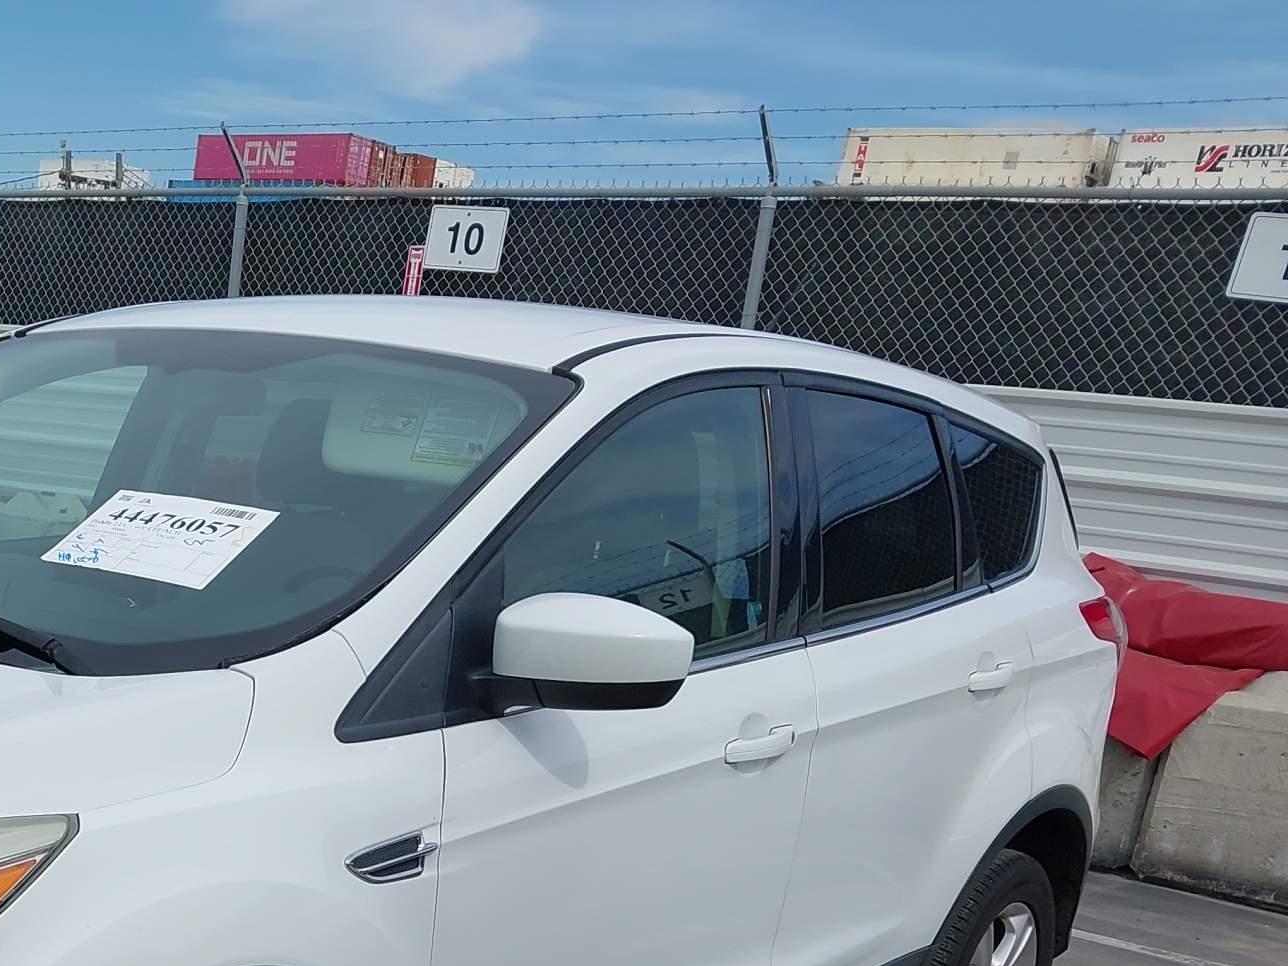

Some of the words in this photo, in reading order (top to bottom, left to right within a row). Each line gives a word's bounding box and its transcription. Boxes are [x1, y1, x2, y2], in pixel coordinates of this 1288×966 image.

[1130, 133, 1165, 143] seaco
[243, 141, 297, 166] ONE
[448, 221, 485, 256] 10
[108, 507, 243, 538] 44476057
